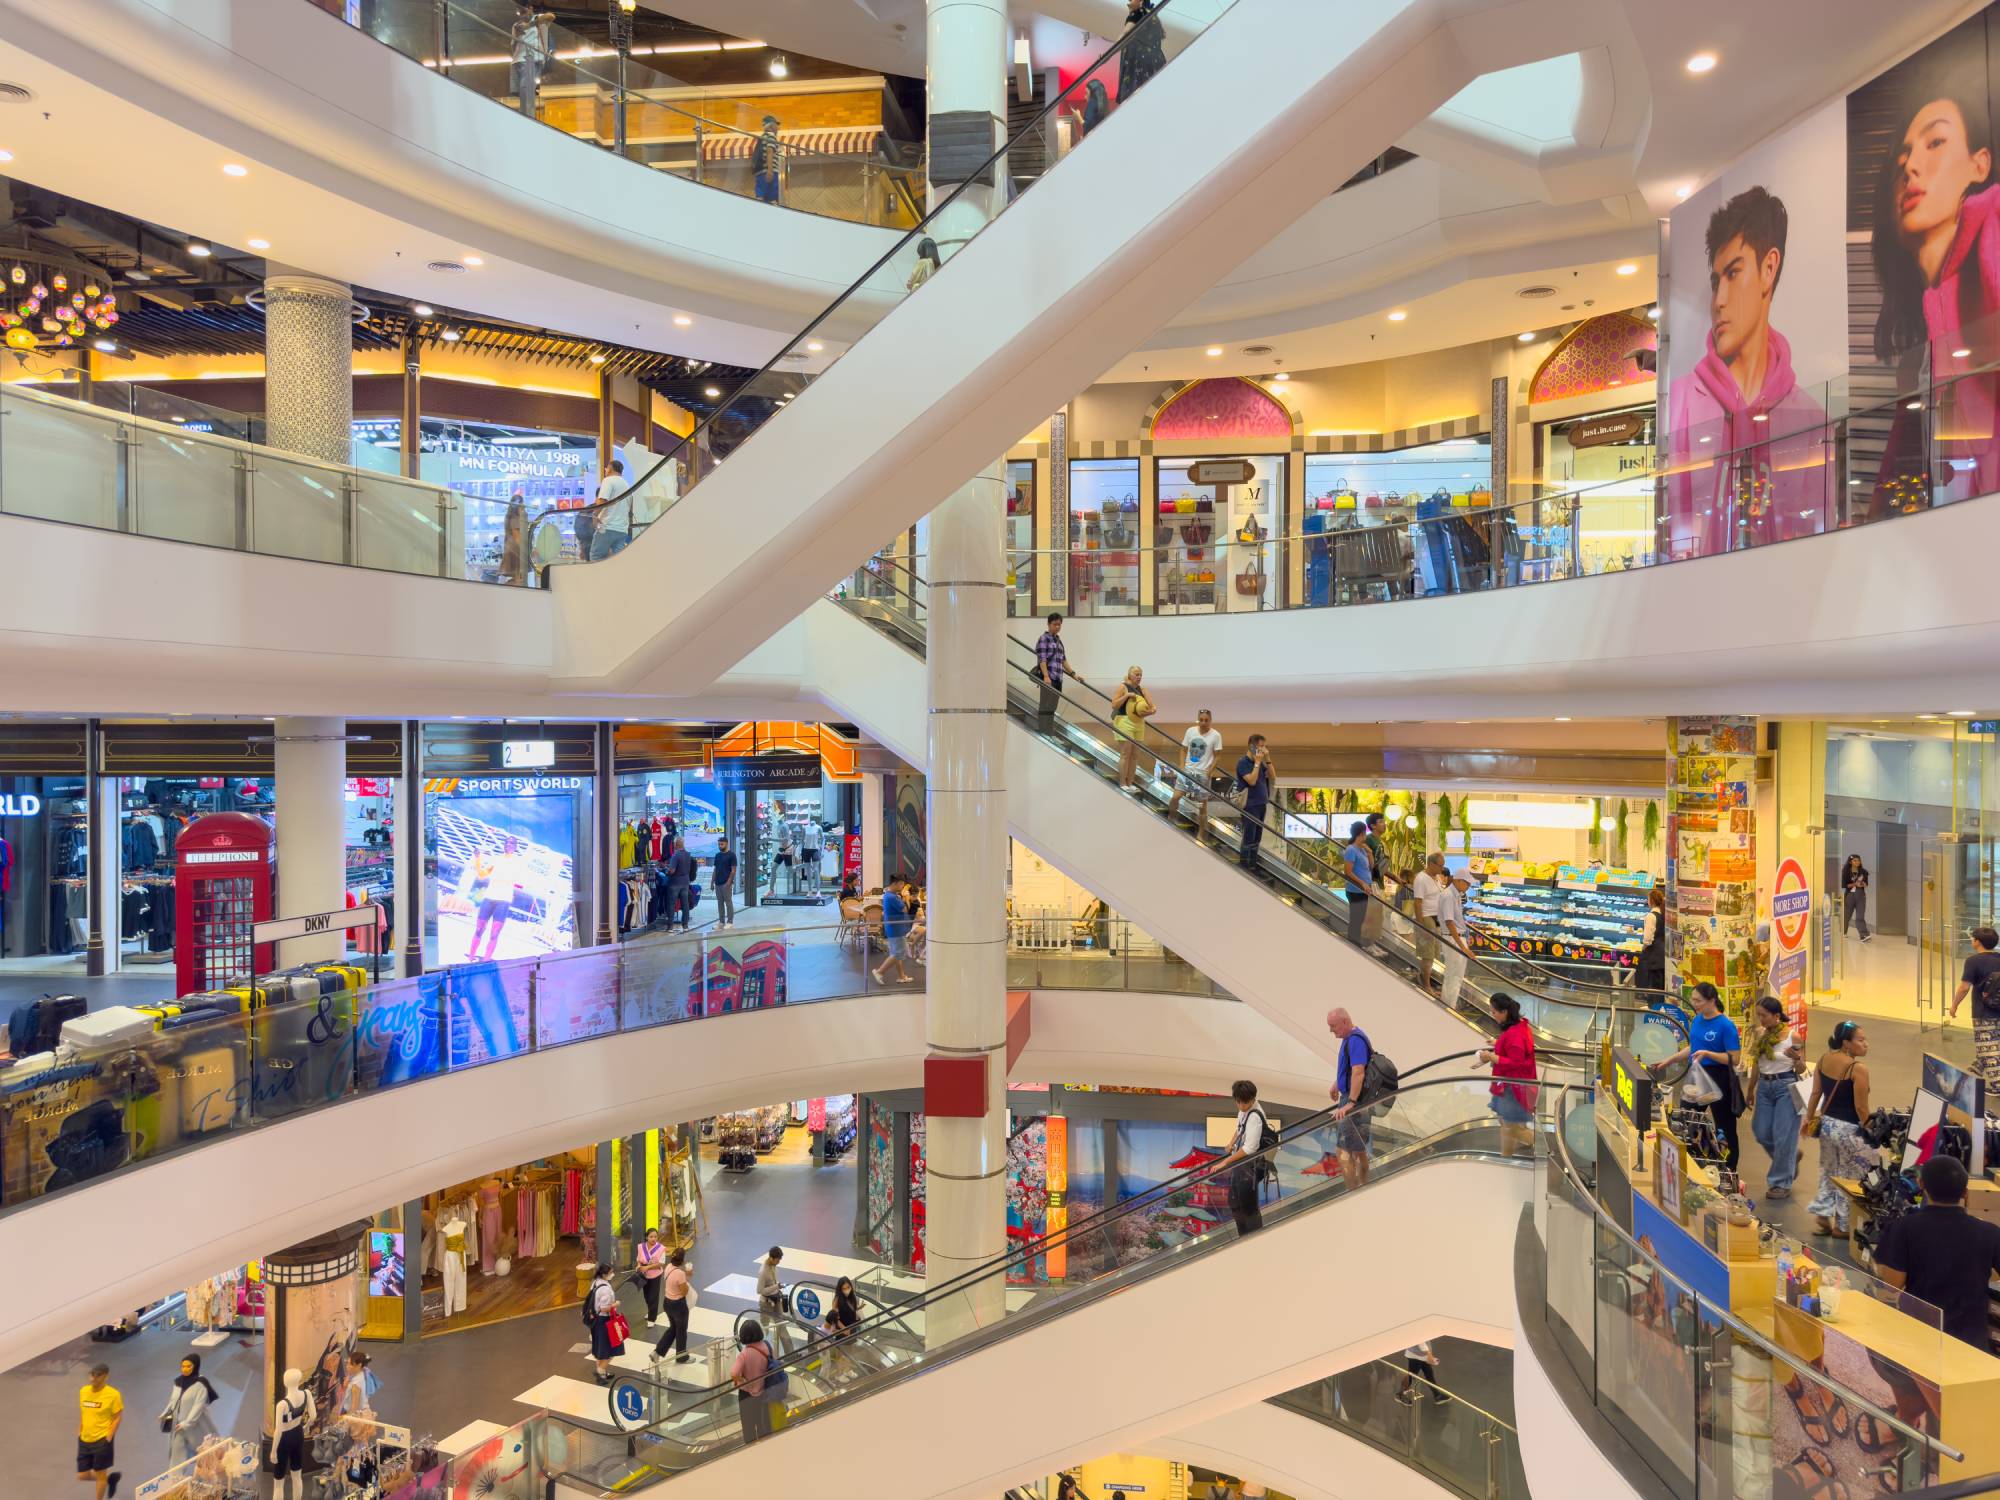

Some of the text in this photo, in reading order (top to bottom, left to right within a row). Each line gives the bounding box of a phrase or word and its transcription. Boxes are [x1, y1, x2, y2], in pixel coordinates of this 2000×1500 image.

[1582, 423, 1627, 439] just.in.case
[443, 440, 580, 466] THANIYA 1988
[459, 456, 565, 479] MN FORMULA
[505, 746, 513, 764] 2
[769, 768, 806, 777] ARCADE
[458, 777, 581, 792] SPORTSWORLD
[191, 852, 257, 862] TELEPHONE
[1774, 895, 1808, 915] MORE SHOP
[305, 914, 331, 932] DKNY
[306, 995, 344, 1045] &
[1648, 1017, 1685, 1028] WARNG
[625, 1391, 633, 1409] 1
[622, 1407, 639, 1418] TOKYO
